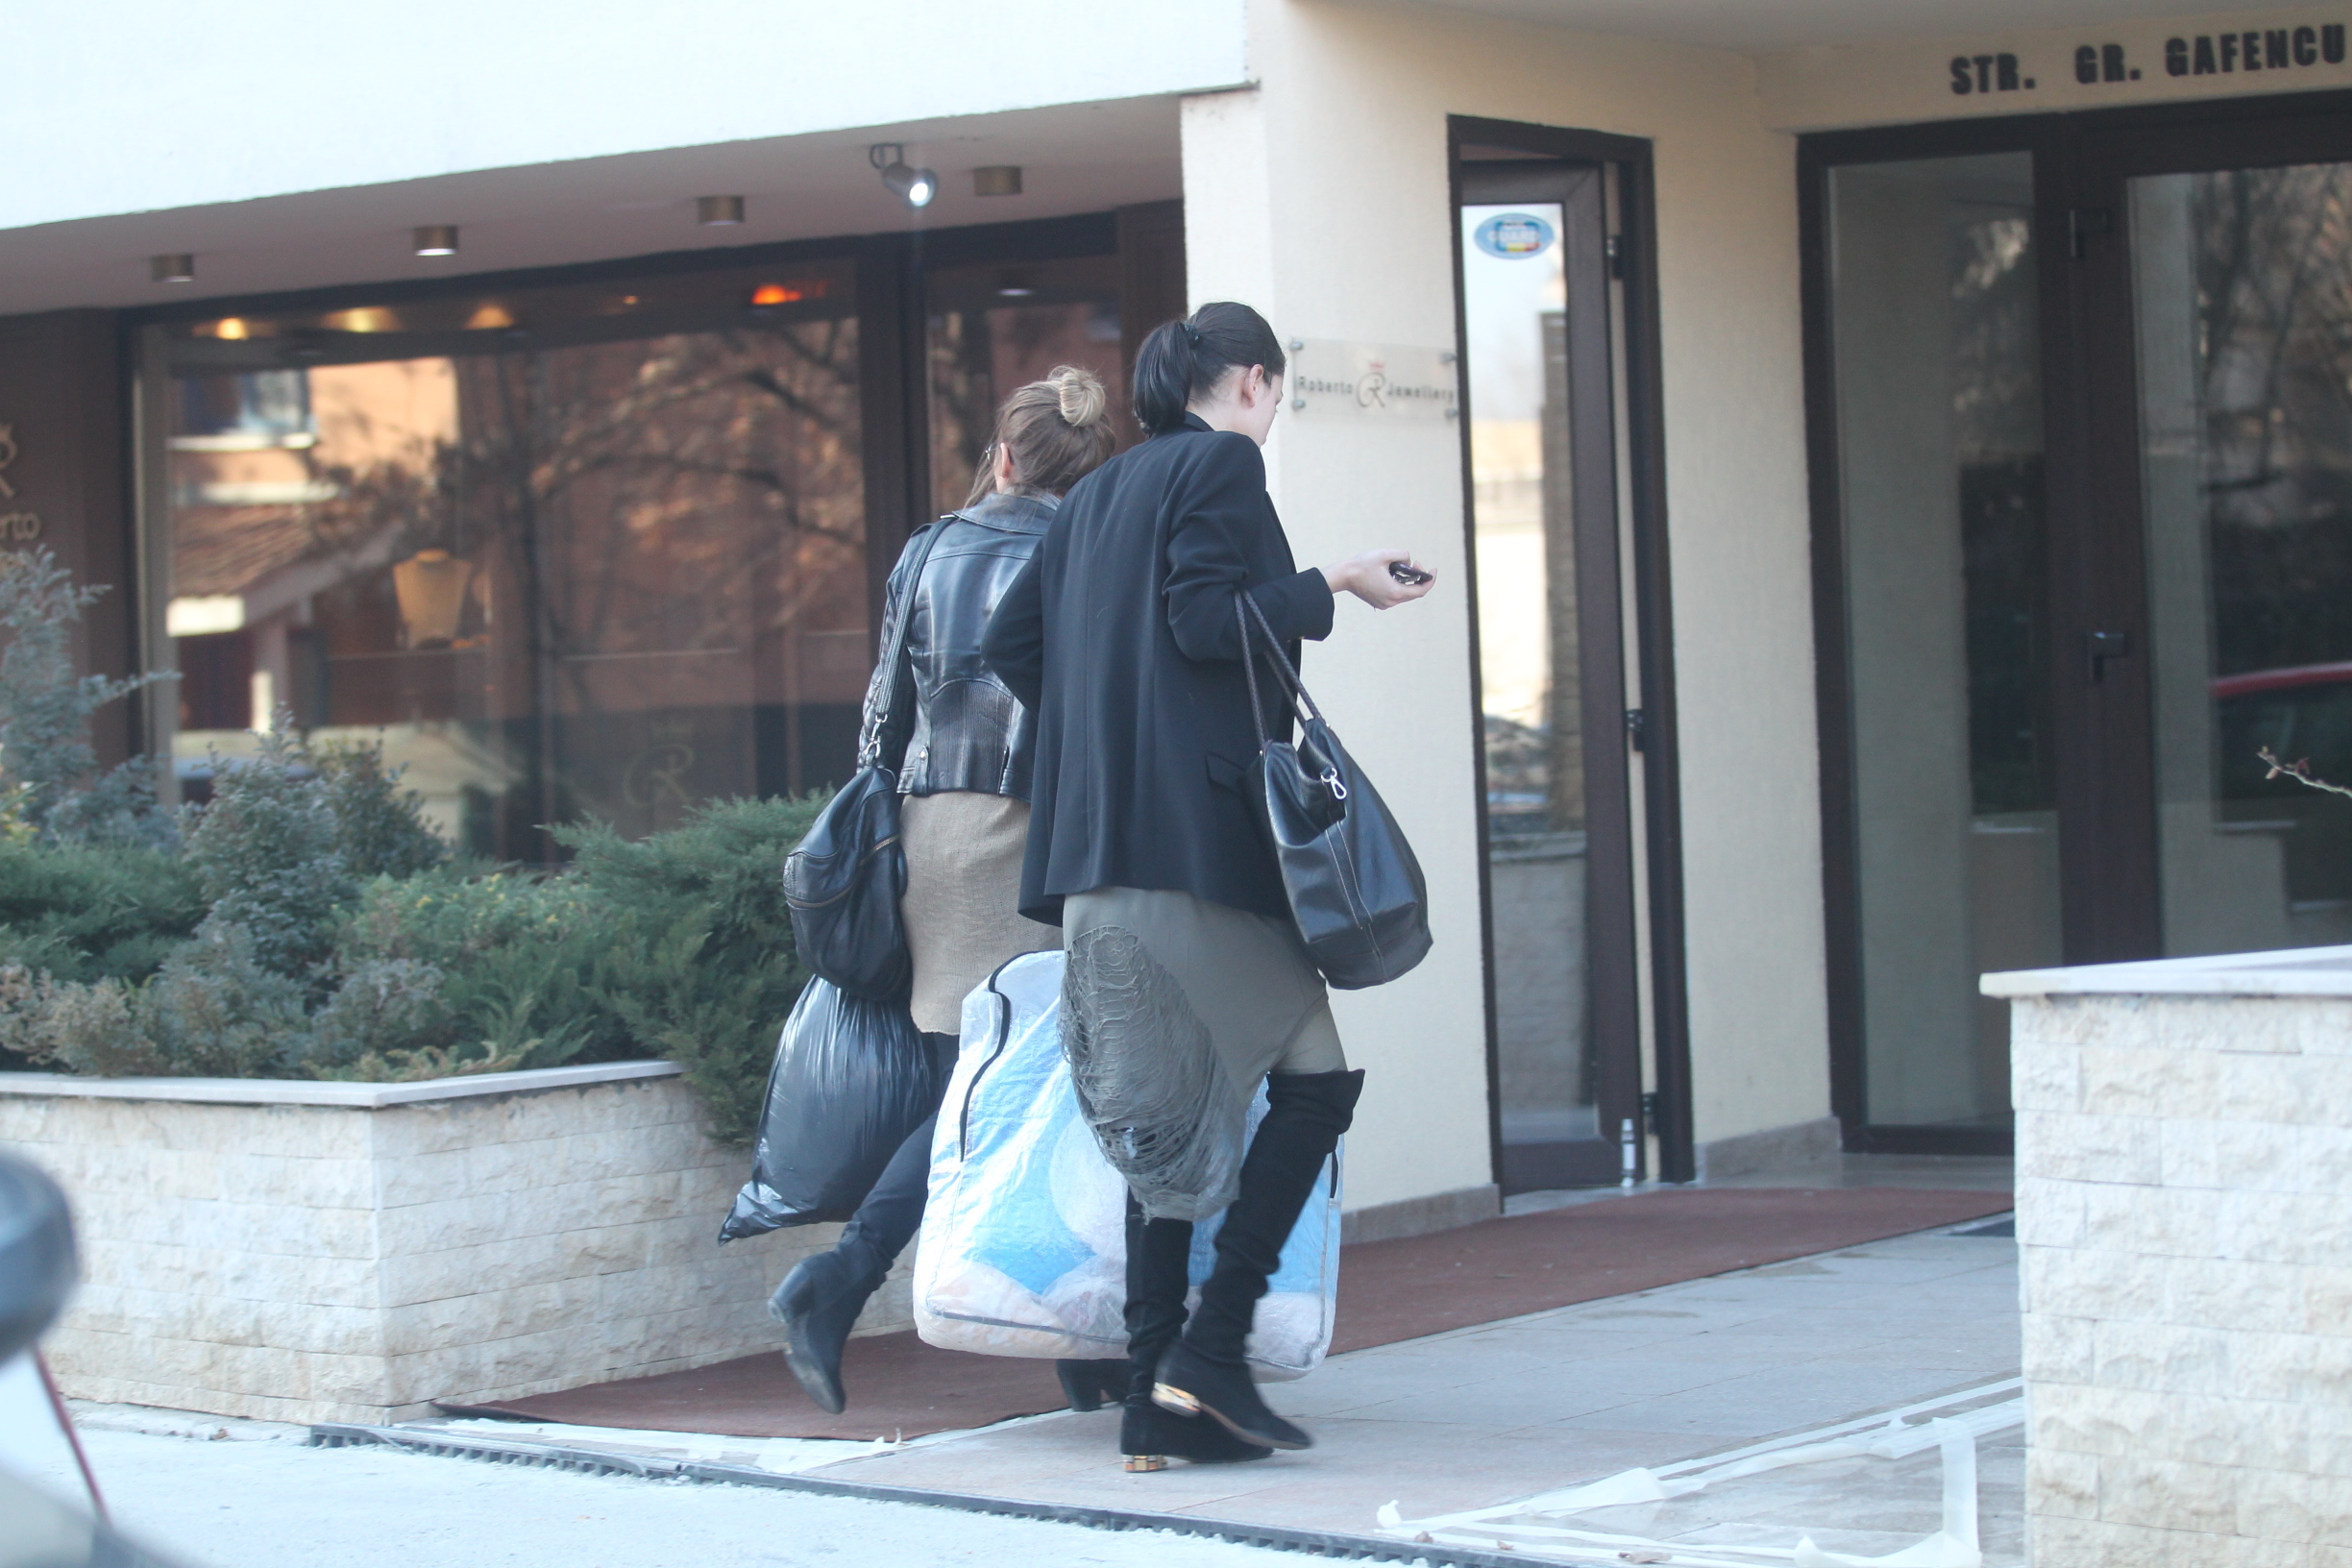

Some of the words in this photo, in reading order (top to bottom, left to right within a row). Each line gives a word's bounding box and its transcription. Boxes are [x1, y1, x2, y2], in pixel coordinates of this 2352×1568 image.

[1949, 53, 2036, 95] STR.
[2073, 43, 2142, 85] GR.
[2165, 23, 2345, 77] GAFENCU
[1298, 375, 1354, 395] Roberto
